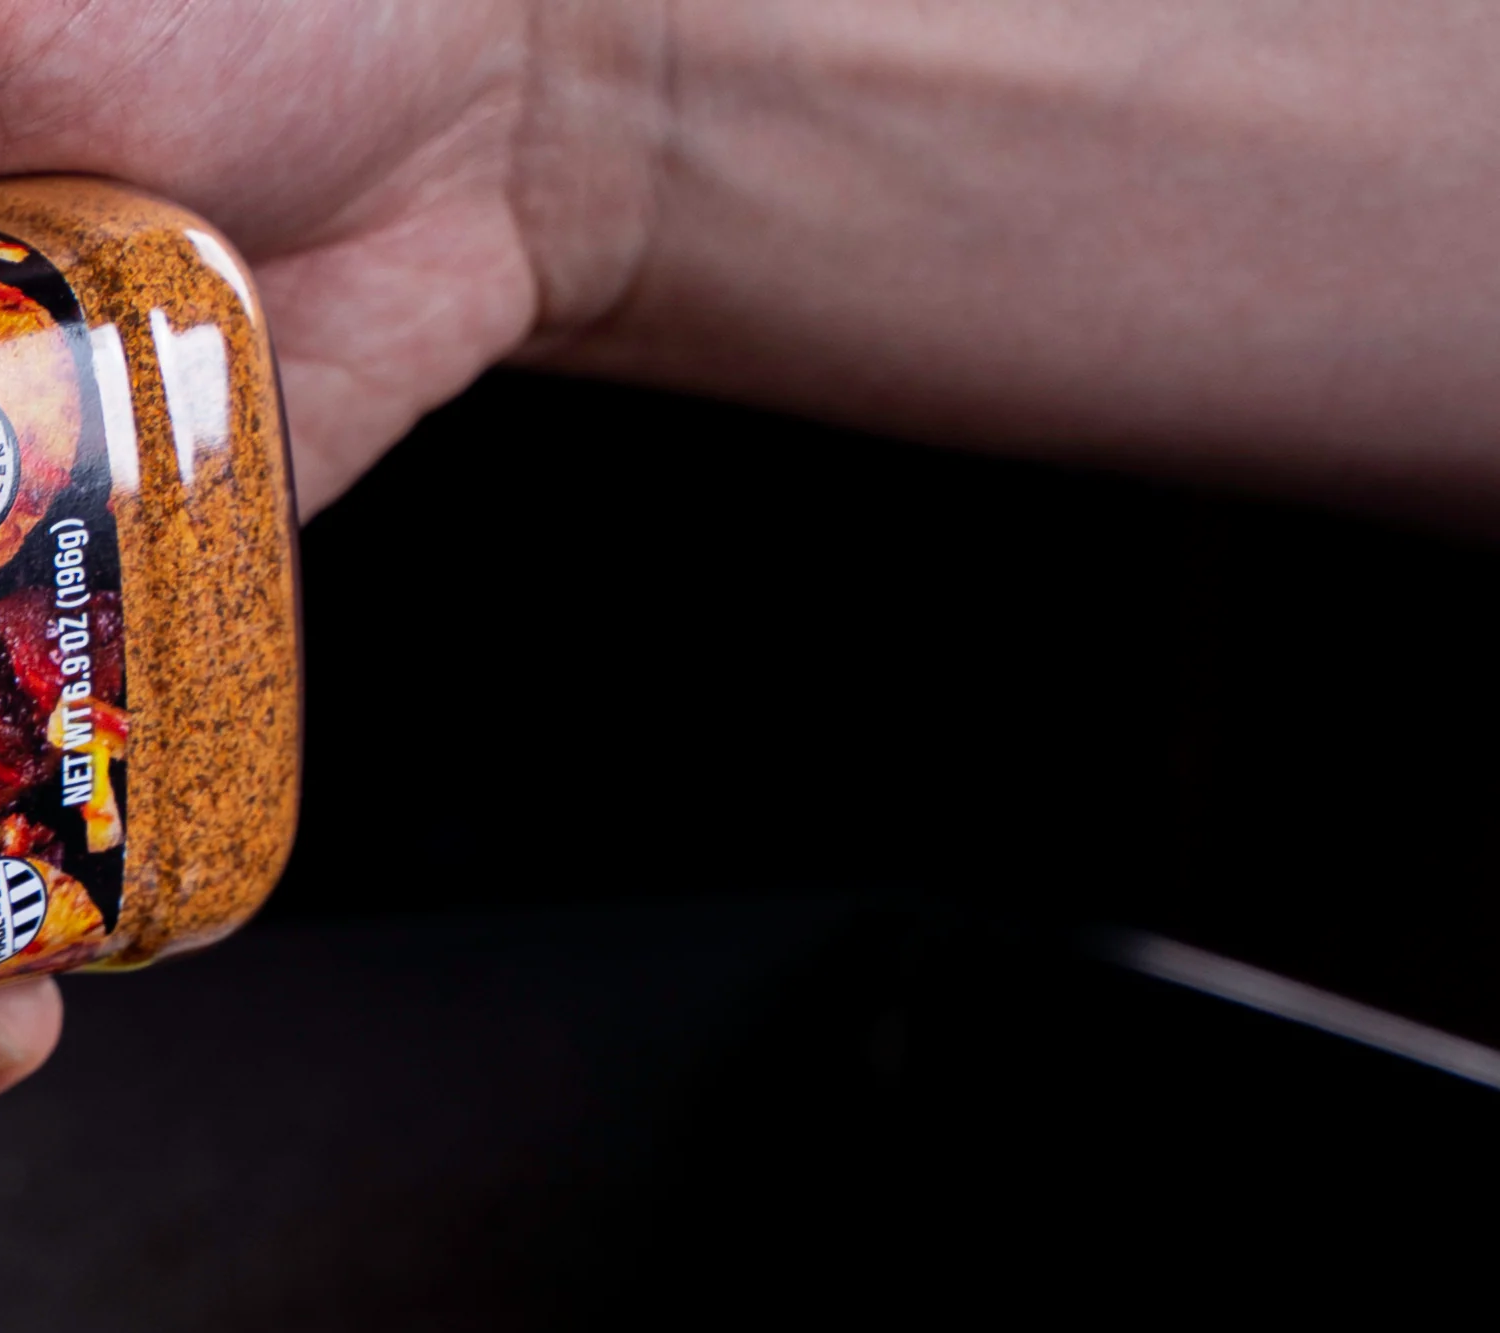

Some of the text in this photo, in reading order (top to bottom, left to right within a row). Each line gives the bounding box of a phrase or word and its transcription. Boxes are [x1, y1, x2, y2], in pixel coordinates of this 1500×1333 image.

[48, 518, 94, 807] NET WT 6.9 OZ (196g)
